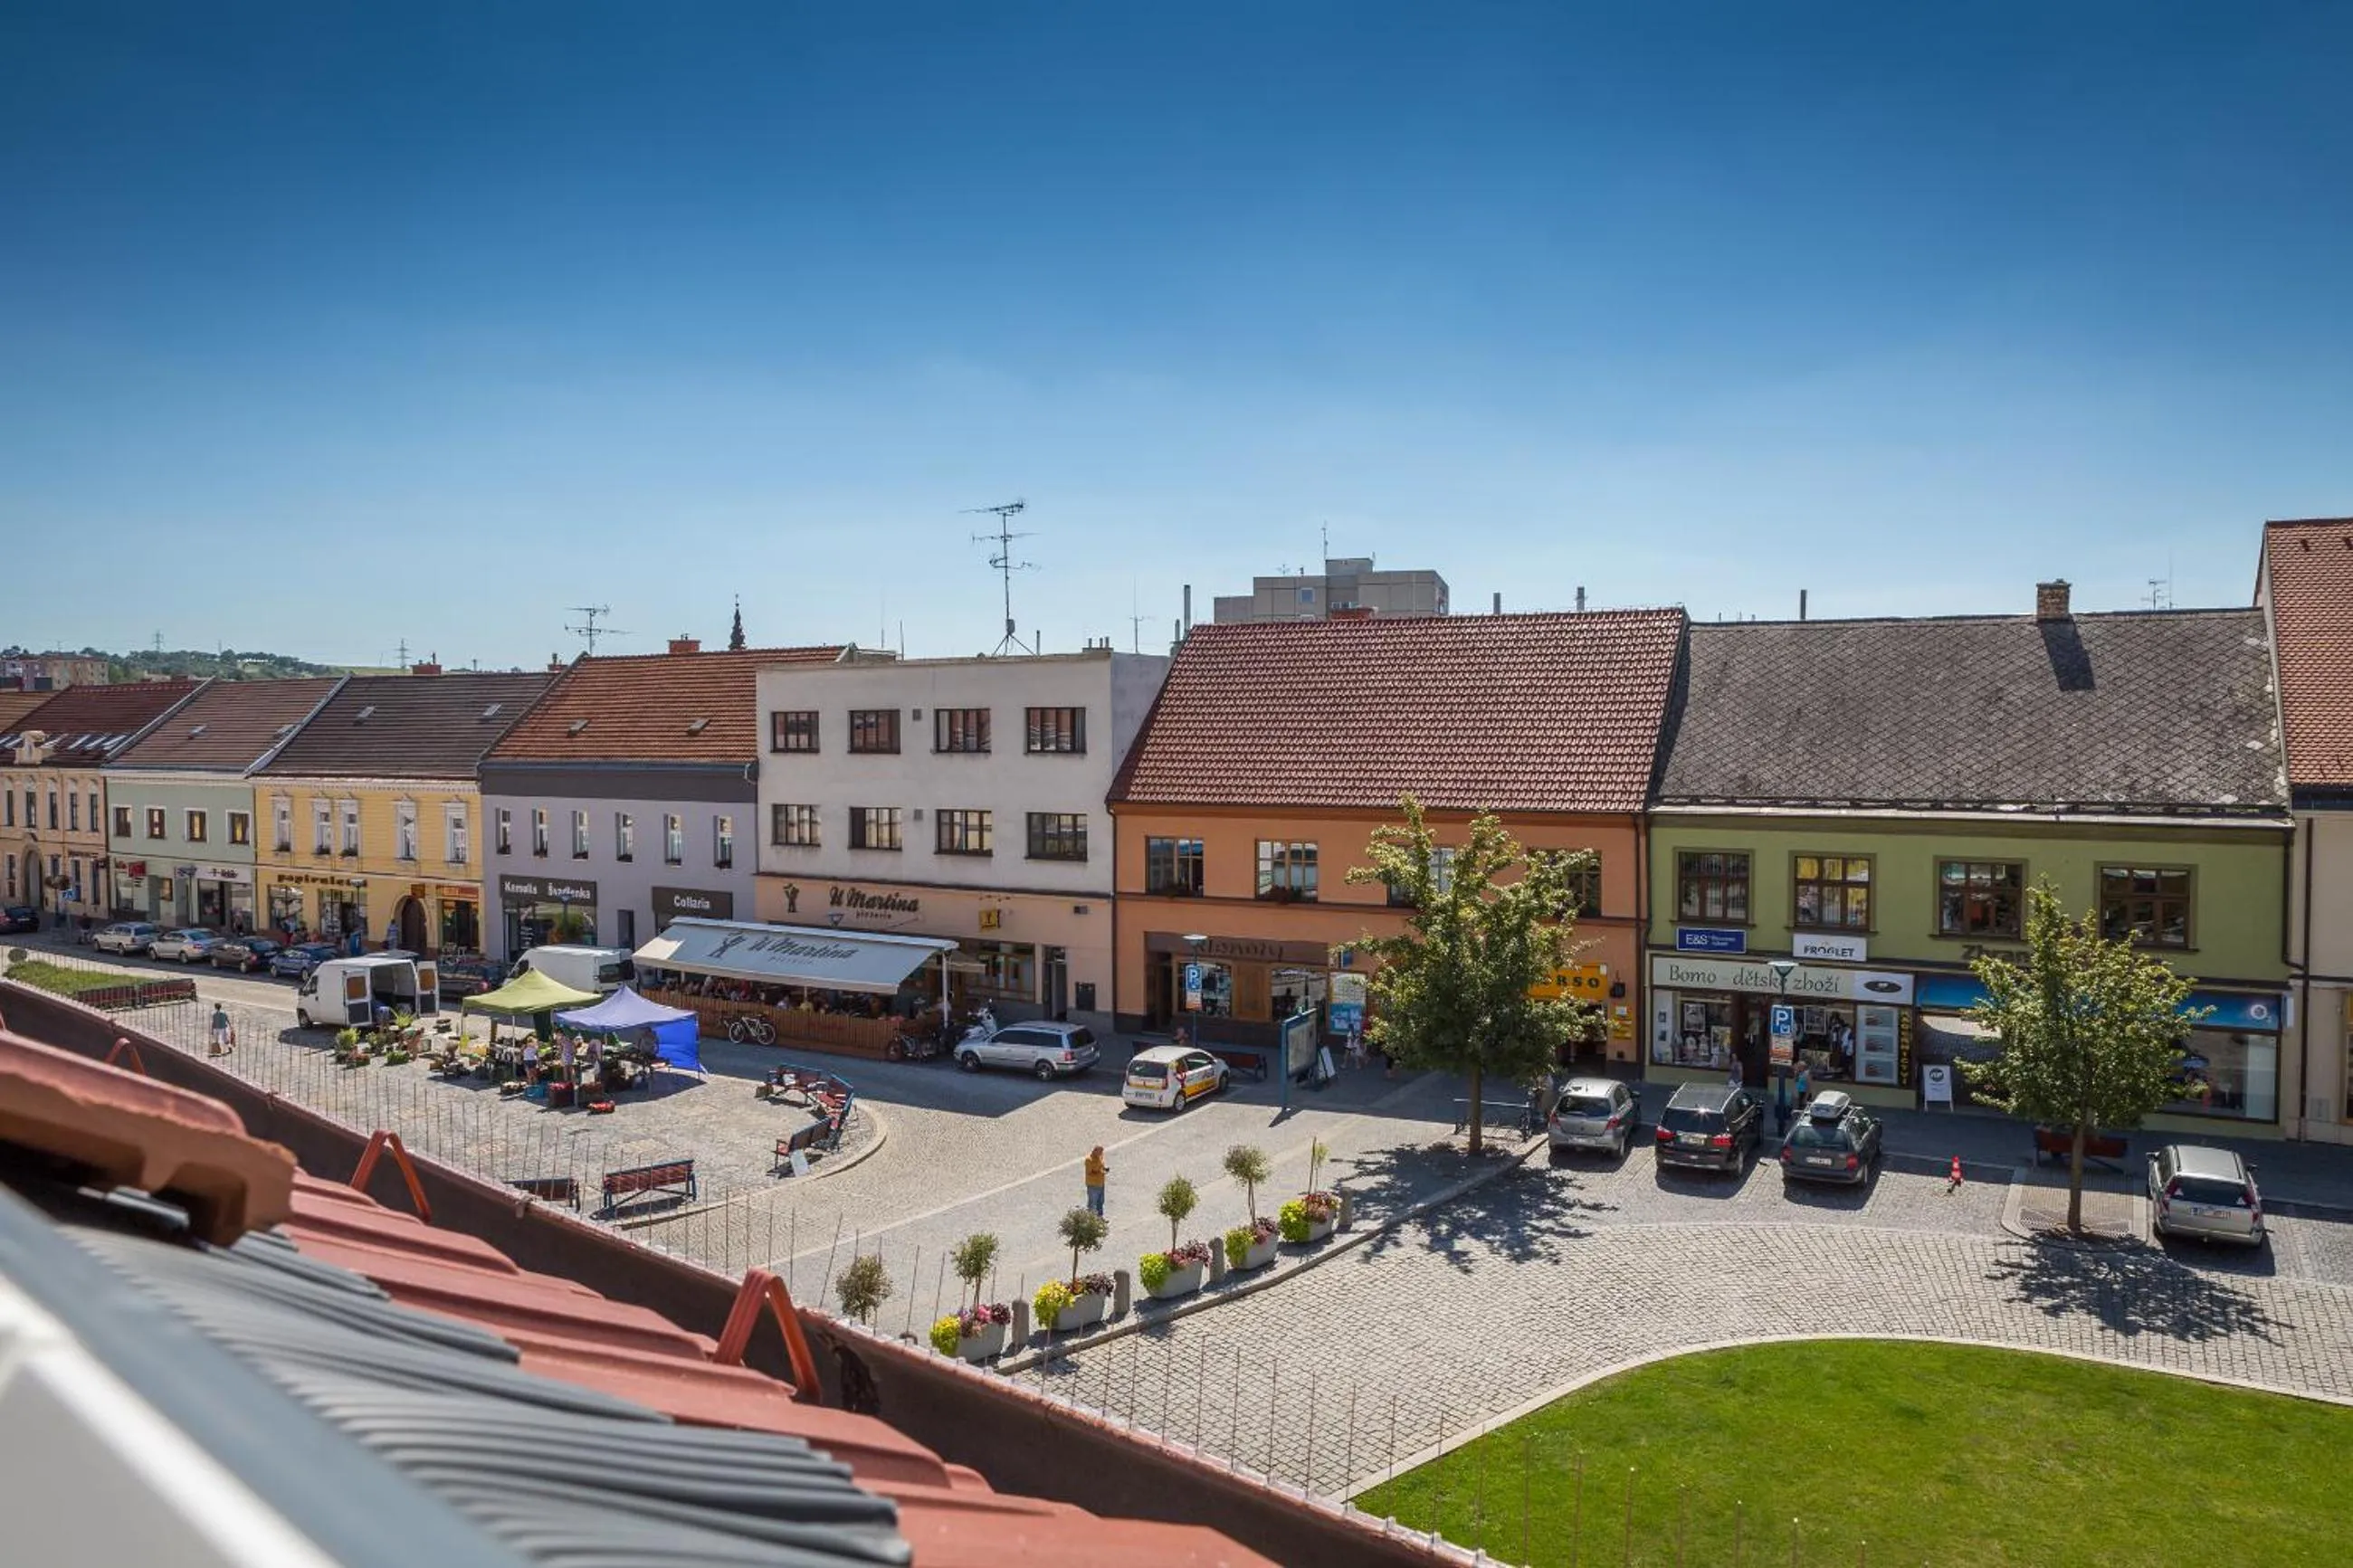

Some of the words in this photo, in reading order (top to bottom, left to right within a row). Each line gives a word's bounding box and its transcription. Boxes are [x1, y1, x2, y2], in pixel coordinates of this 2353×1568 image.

[846, 888, 919, 912] Martina
[1669, 965, 1717, 984] Bomo
[1793, 971, 1841, 993] zboží
[1776, 1009, 1789, 1026] P
